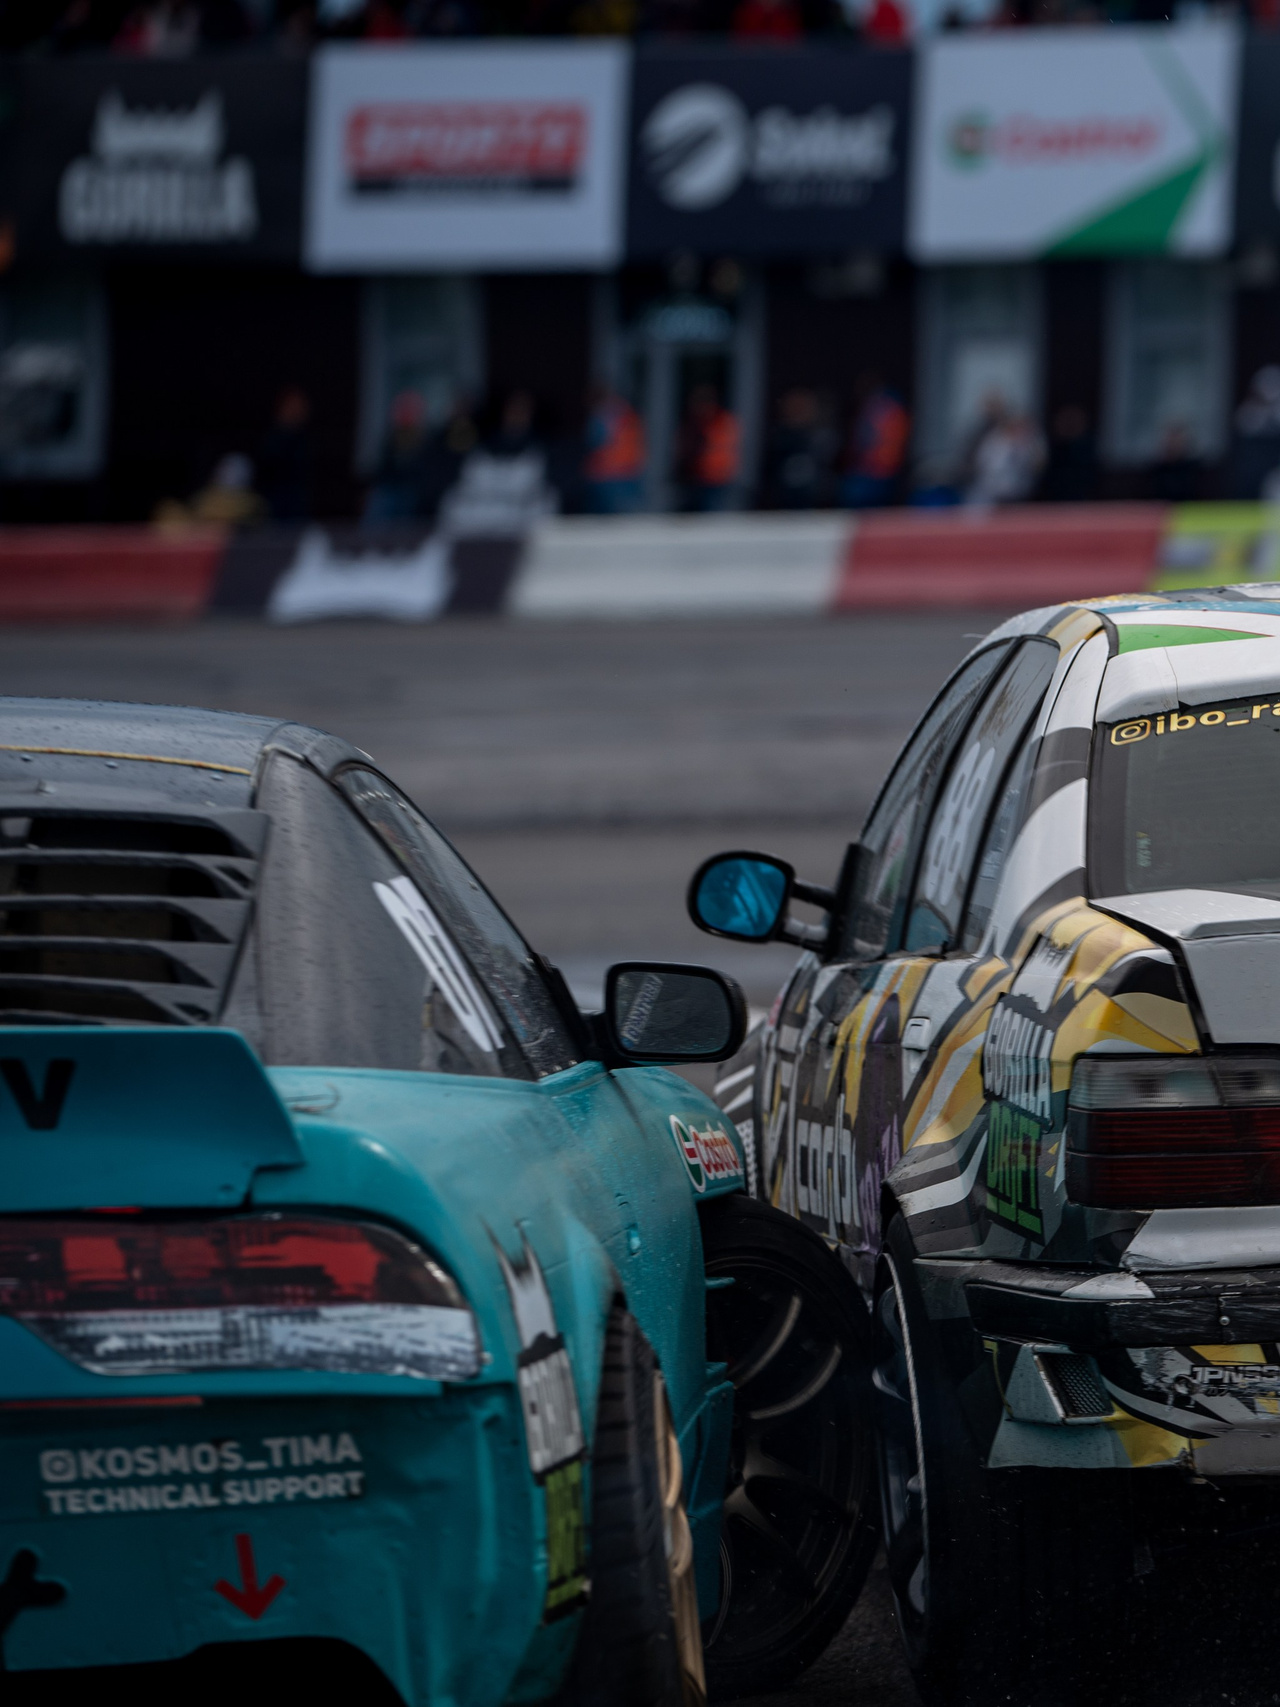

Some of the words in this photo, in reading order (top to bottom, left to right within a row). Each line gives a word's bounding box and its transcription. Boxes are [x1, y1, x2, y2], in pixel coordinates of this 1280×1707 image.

[80, 1432, 362, 1480] KOSMOS_TIMA
[44, 1483, 221, 1514] TECHNICAL
[221, 1471, 365, 1505] SUPPORT
